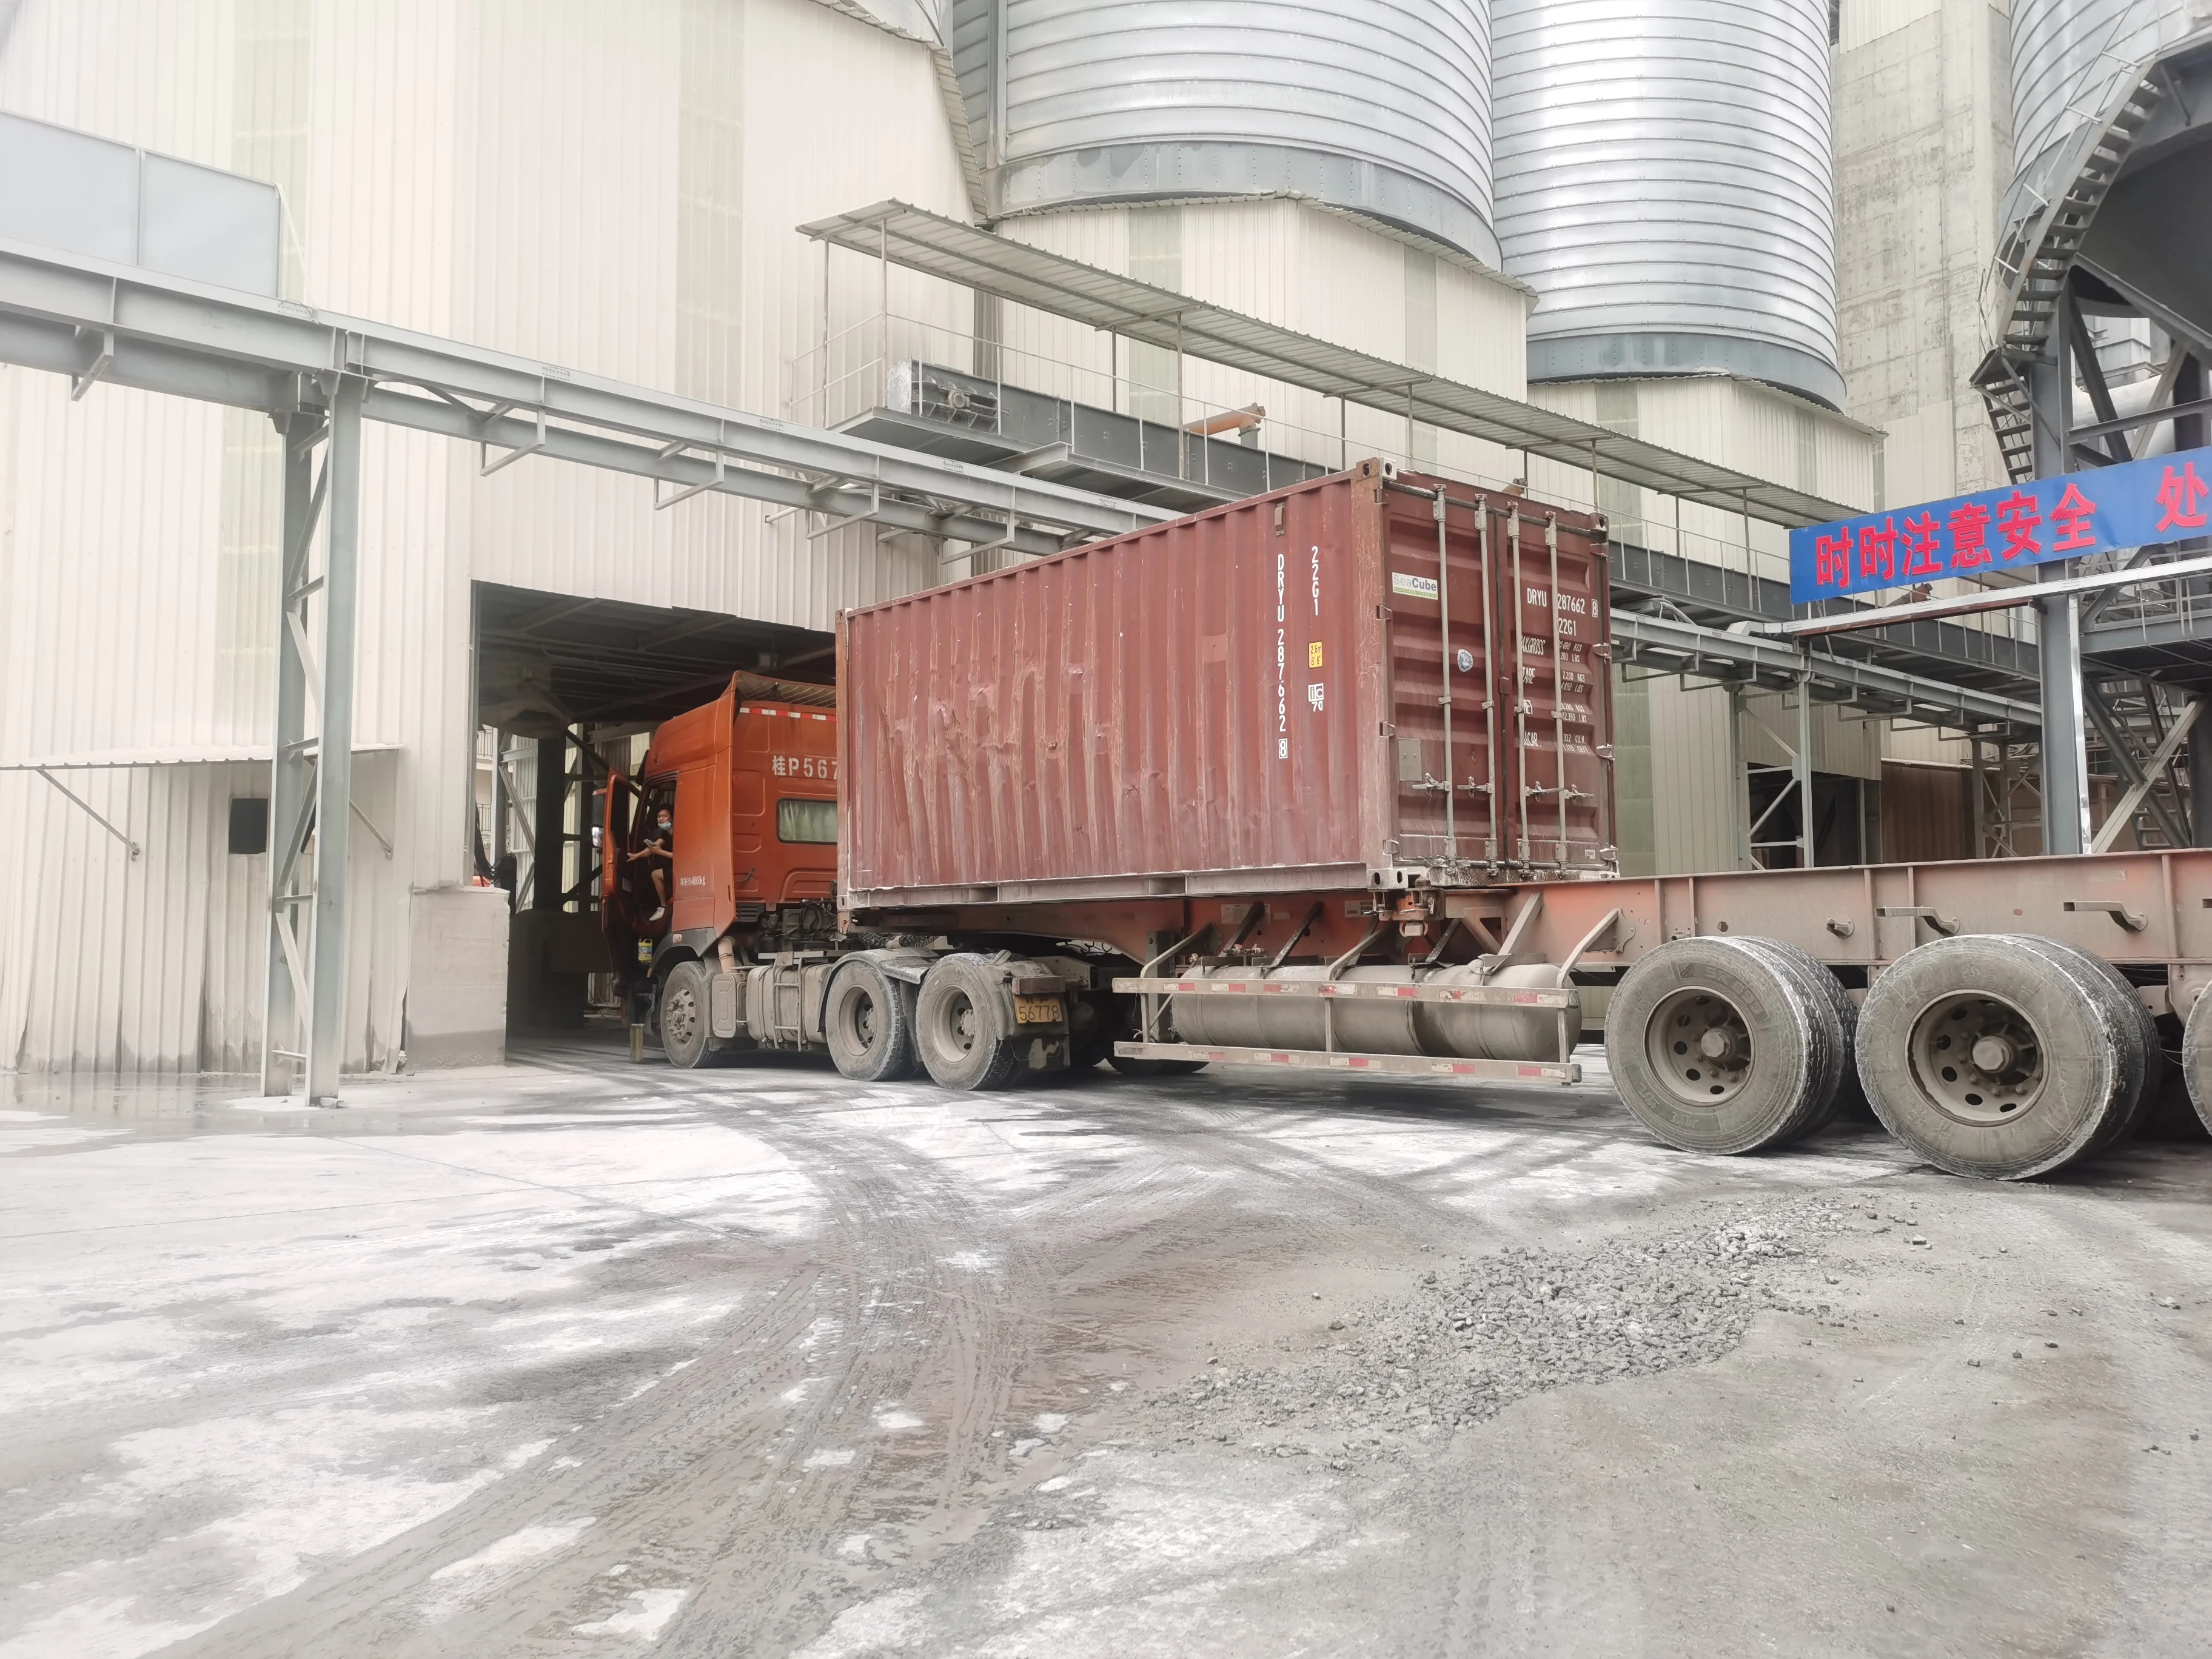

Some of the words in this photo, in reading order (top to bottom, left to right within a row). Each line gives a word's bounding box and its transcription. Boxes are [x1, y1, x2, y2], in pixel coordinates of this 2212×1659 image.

[1815, 483, 2096, 588] 时时注意安全
[2154, 461, 2209, 533] 处
[1393, 574, 1437, 592] SeaCube
[1527, 588, 1547, 607] DRYU
[1557, 593, 1586, 614] 287662
[1592, 599, 1598, 617] 8
[1558, 617, 1577, 636] 22G1
[1573, 643, 1583, 652] KGS
[1277, 628, 1287, 732] 287662
[1577, 673, 1586, 683] KGS
[1312, 700, 1324, 712] 70
[1576, 705, 1586, 713] KGS
[1279, 739, 1287, 758] 8
[1019, 1005, 1060, 1021] 56778
